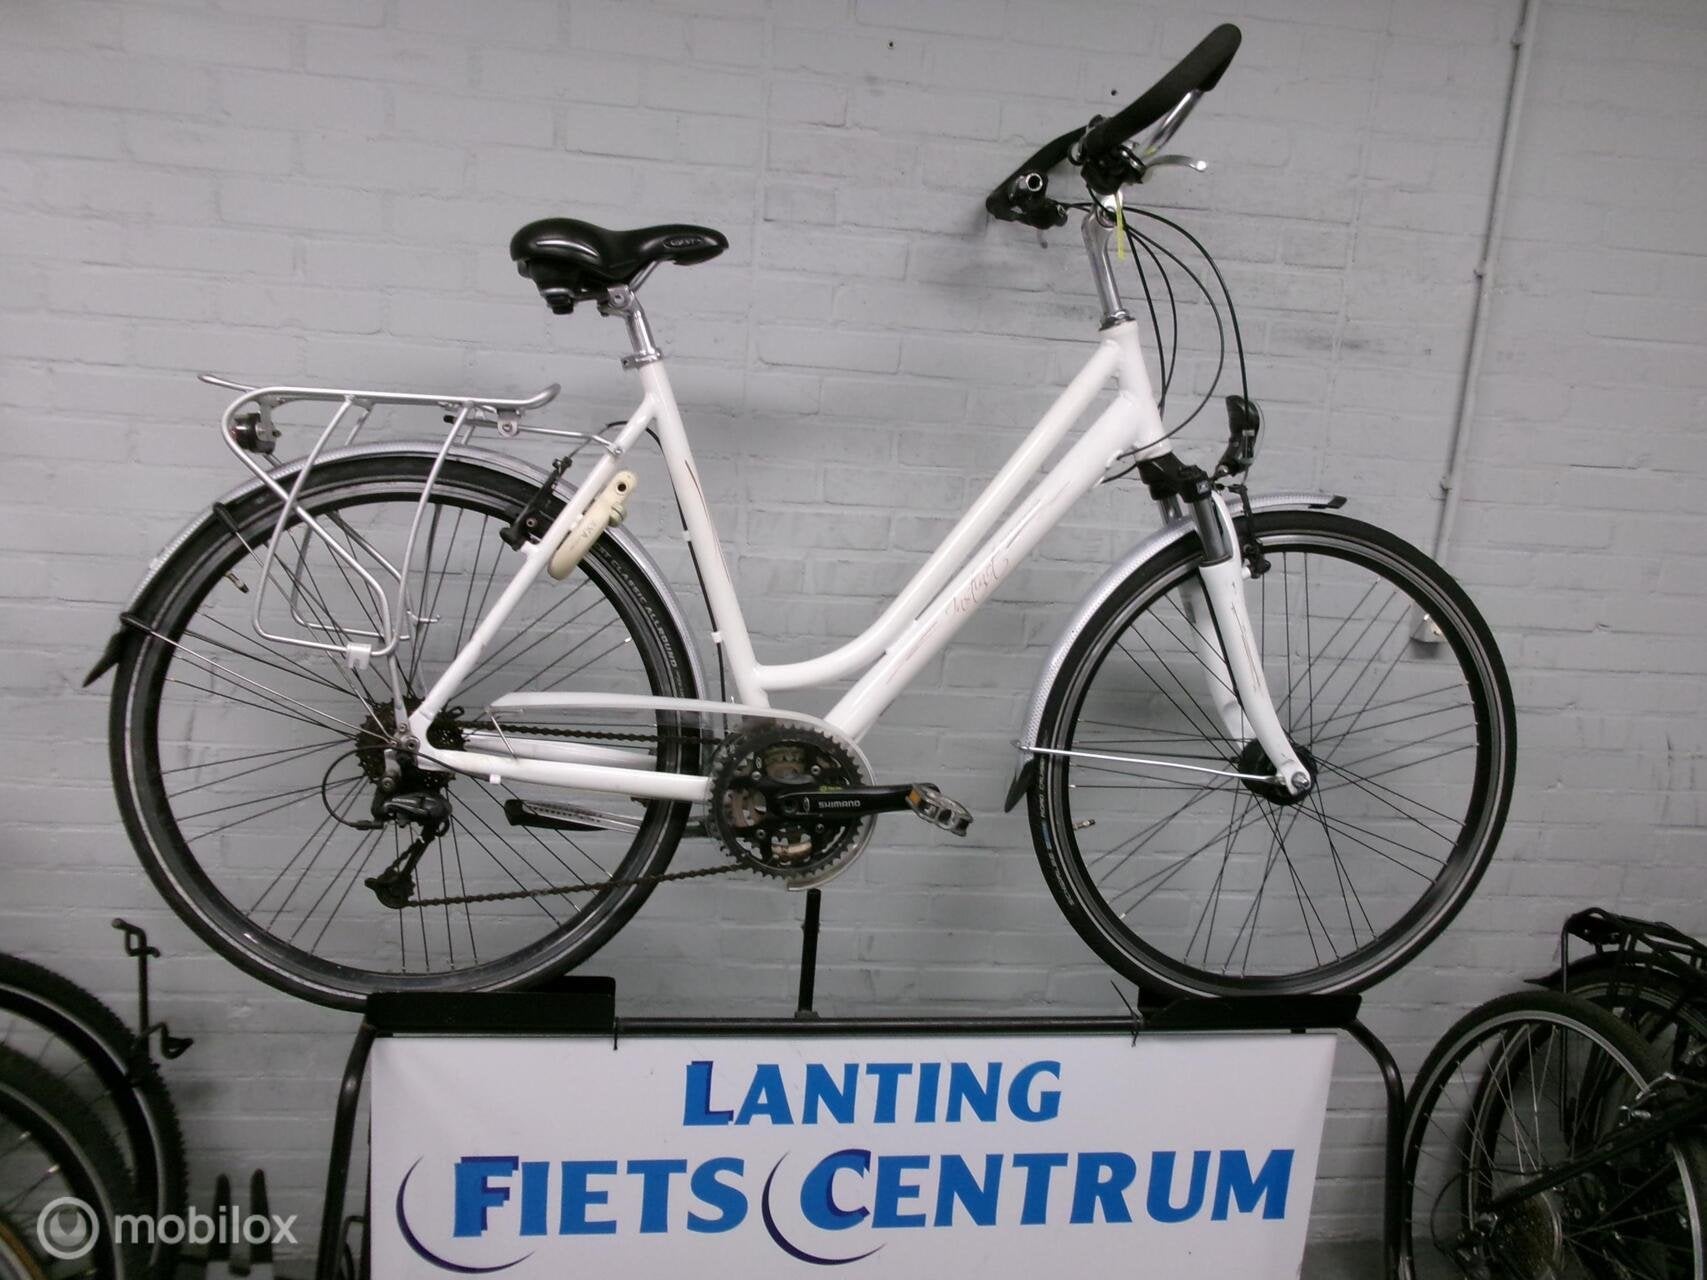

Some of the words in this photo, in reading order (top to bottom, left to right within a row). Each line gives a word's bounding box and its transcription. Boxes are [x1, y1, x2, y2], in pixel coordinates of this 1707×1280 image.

[645, 606, 678, 668] ALLROUND
[818, 800, 861, 809] SHIMANO
[684, 1060, 1062, 1127] LANTING
[453, 1155, 749, 1238] FIETS
[800, 1149, 1294, 1232] CENTRUM
